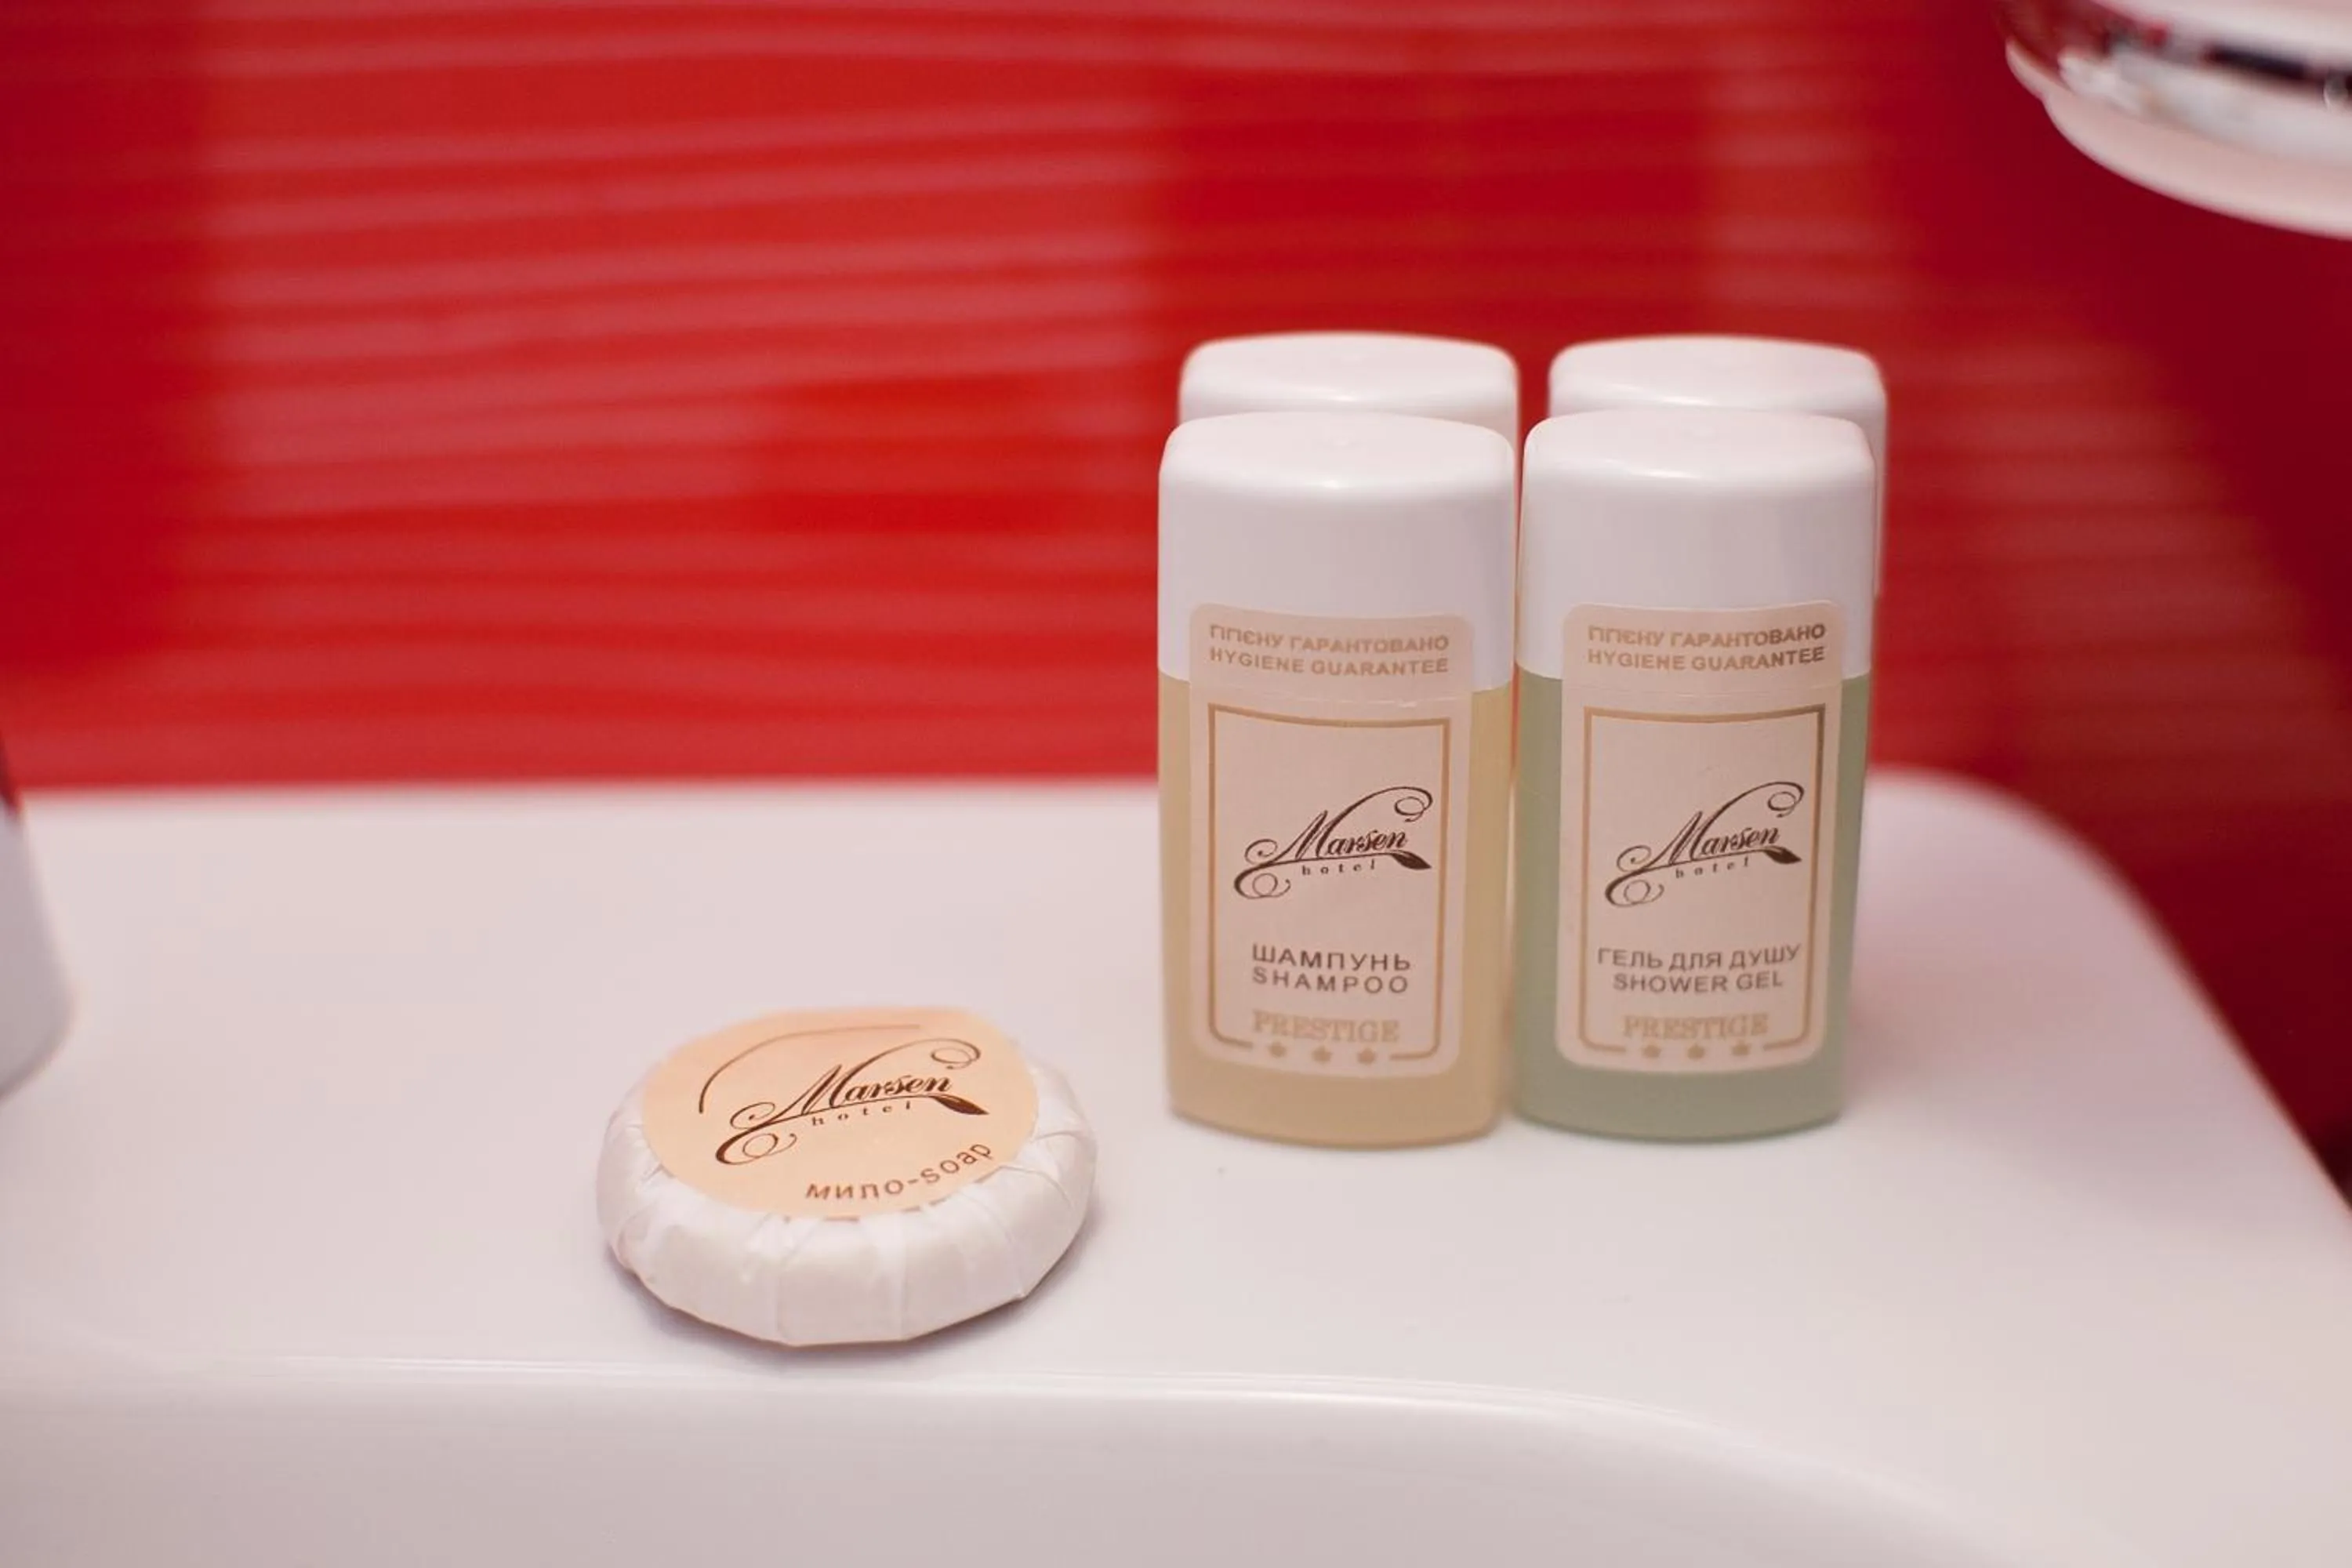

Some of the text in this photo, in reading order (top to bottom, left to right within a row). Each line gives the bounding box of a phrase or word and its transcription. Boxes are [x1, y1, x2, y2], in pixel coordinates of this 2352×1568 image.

[1290, 635, 1449, 653] ГАРАНТОВАНО
[1671, 624, 1826, 648] ГАРАНТОВАНО
[1210, 647, 1449, 676] HYGIENE GUARANTEE
[1588, 647, 1825, 671] HYGIENE GUARANTEE
[1301, 859, 1376, 876] hotel
[1675, 856, 1750, 879] hotel
[1253, 945, 1410, 971] ШАМПУНЬ
[1597, 944, 1802, 971] ГЕЛЬ ДЛЯ ДУШУ
[1252, 967, 1409, 994] SHAMPOO
[1613, 971, 1784, 993] SHOWER GEL
[1252, 1010, 1399, 1043] PRESTIGE
[1621, 1014, 1769, 1040] PRESTIGE
[811, 1102, 913, 1126] hotel
